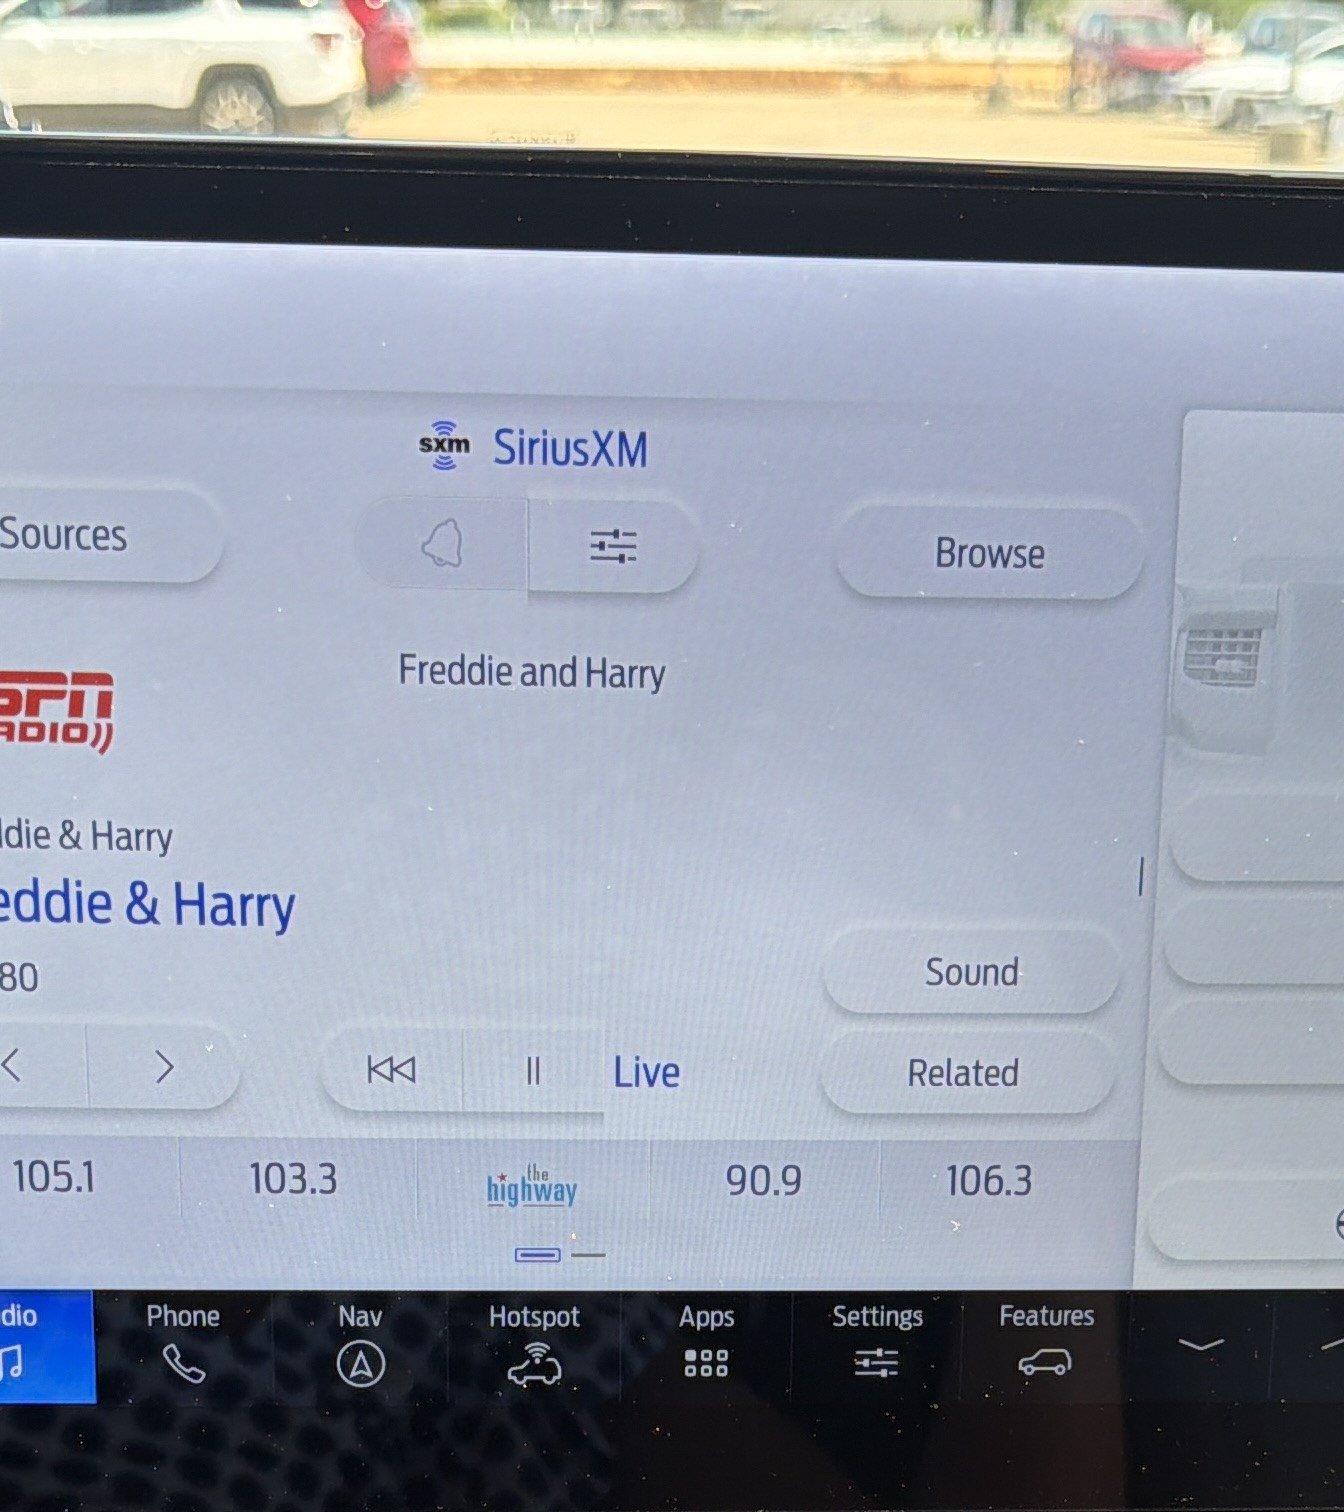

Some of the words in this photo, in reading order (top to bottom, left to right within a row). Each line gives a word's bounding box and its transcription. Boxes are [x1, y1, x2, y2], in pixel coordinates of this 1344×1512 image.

[419, 430, 470, 454] sxm
[494, 427, 647, 468] SiriusXM
[0, 515, 128, 552] Sources
[936, 536, 1045, 569] Browse
[400, 652, 513, 687] Freddie
[520, 655, 577, 688] and
[586, 656, 667, 695] Harry
[58, 819, 83, 850] &
[91, 819, 173, 858] Harry
[125, 880, 161, 925] &
[174, 881, 296, 937] Harry
[925, 955, 1019, 987] Sound
[615, 1055, 680, 1088] Live
[908, 1057, 1019, 1087] Related
[12, 1159, 94, 1193] 105.1
[250, 1161, 337, 1195] 103.3
[527, 1162, 549, 1182] the
[726, 1164, 802, 1196] 90.9
[947, 1164, 1032, 1196] 106.3
[487, 1174, 578, 1208] highway
[147, 1303, 220, 1327] Phone
[339, 1304, 383, 1328] Nav
[490, 1305, 581, 1332] Hotspot
[679, 1304, 735, 1332] Apps
[832, 1305, 924, 1332] Settings
[1000, 1304, 1095, 1327] Features
